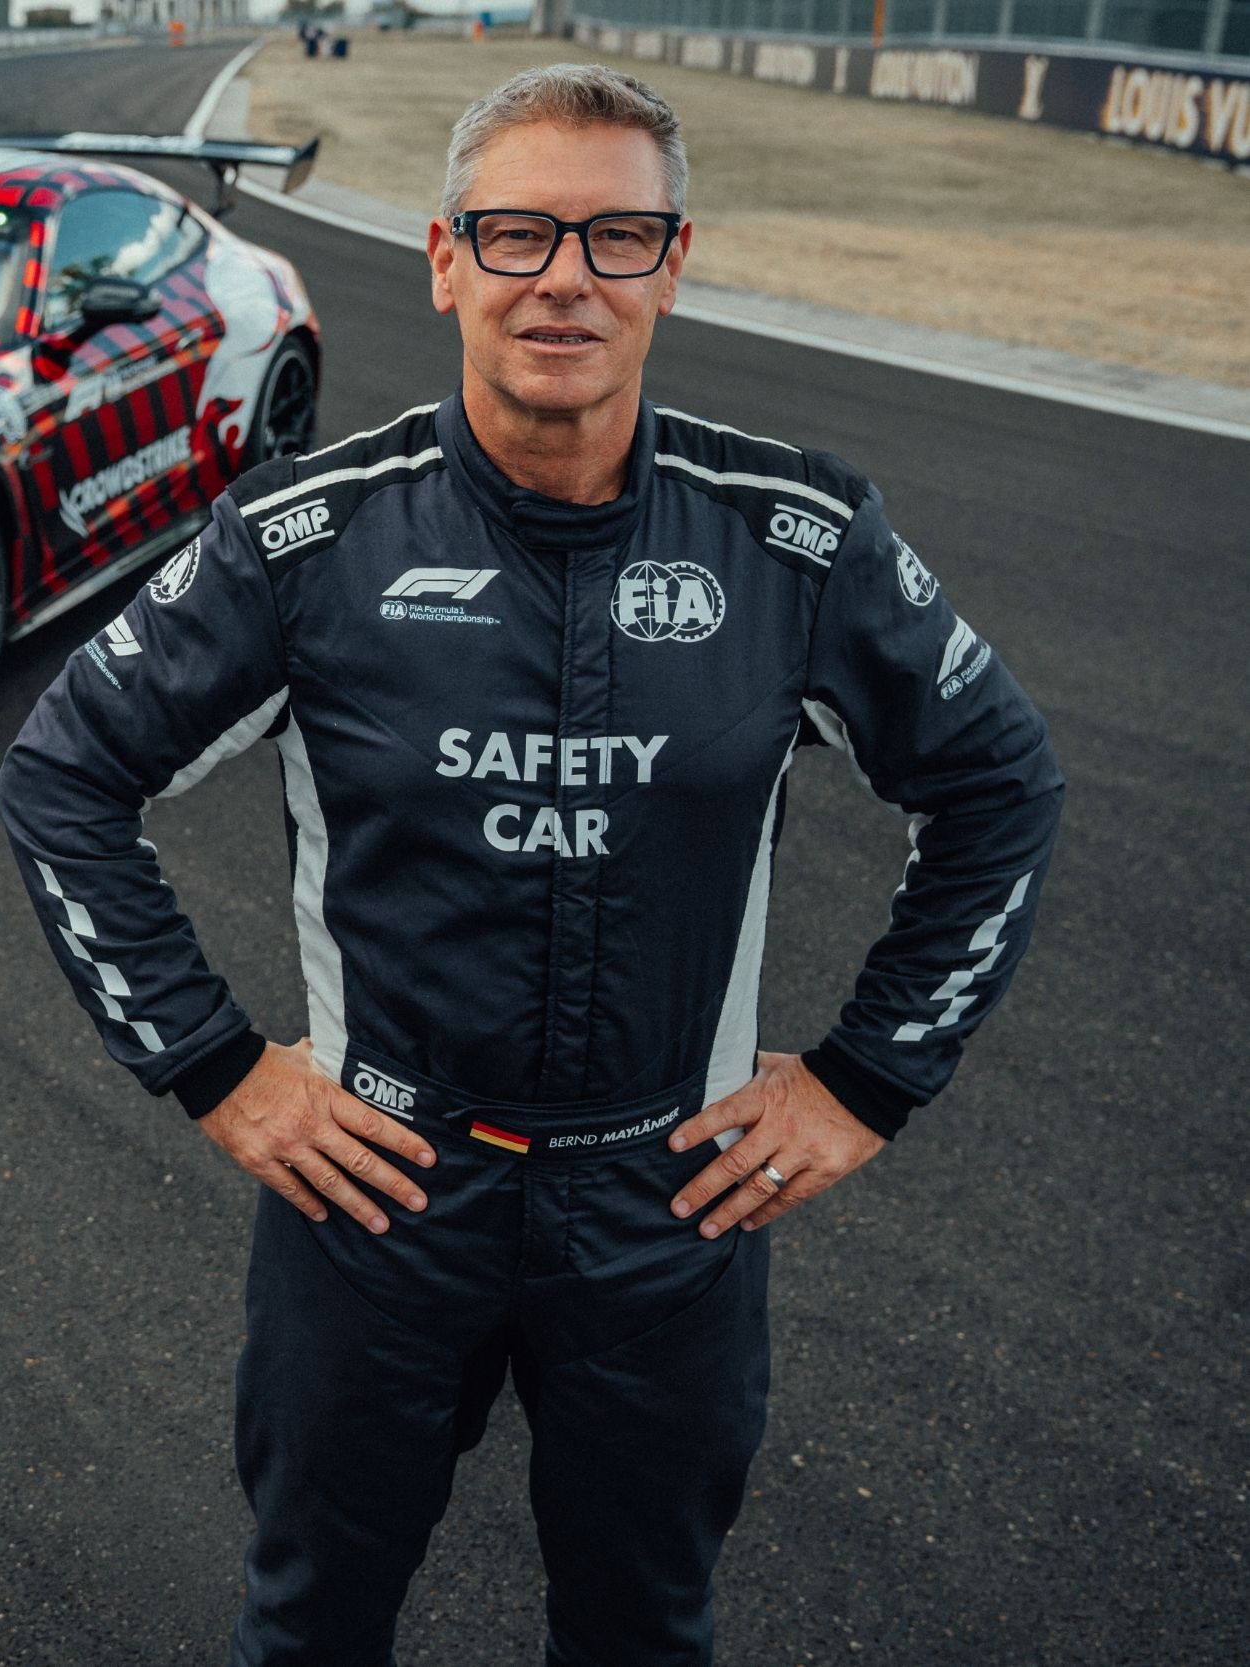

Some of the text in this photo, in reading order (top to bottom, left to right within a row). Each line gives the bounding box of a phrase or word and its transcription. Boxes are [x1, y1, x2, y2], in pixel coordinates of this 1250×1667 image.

[261, 505, 330, 550] OMP
[769, 512, 839, 556] OMP
[381, 567, 502, 600] F1
[409, 604, 423, 612] FIA
[424, 606, 459, 614] Formula
[409, 611, 494, 625] World Championship
[435, 727, 670, 786] SAFETY
[483, 803, 610, 858] CAR
[353, 1071, 415, 1111] OMP
[548, 1106, 680, 1148] BERND MAYLÄNDER
